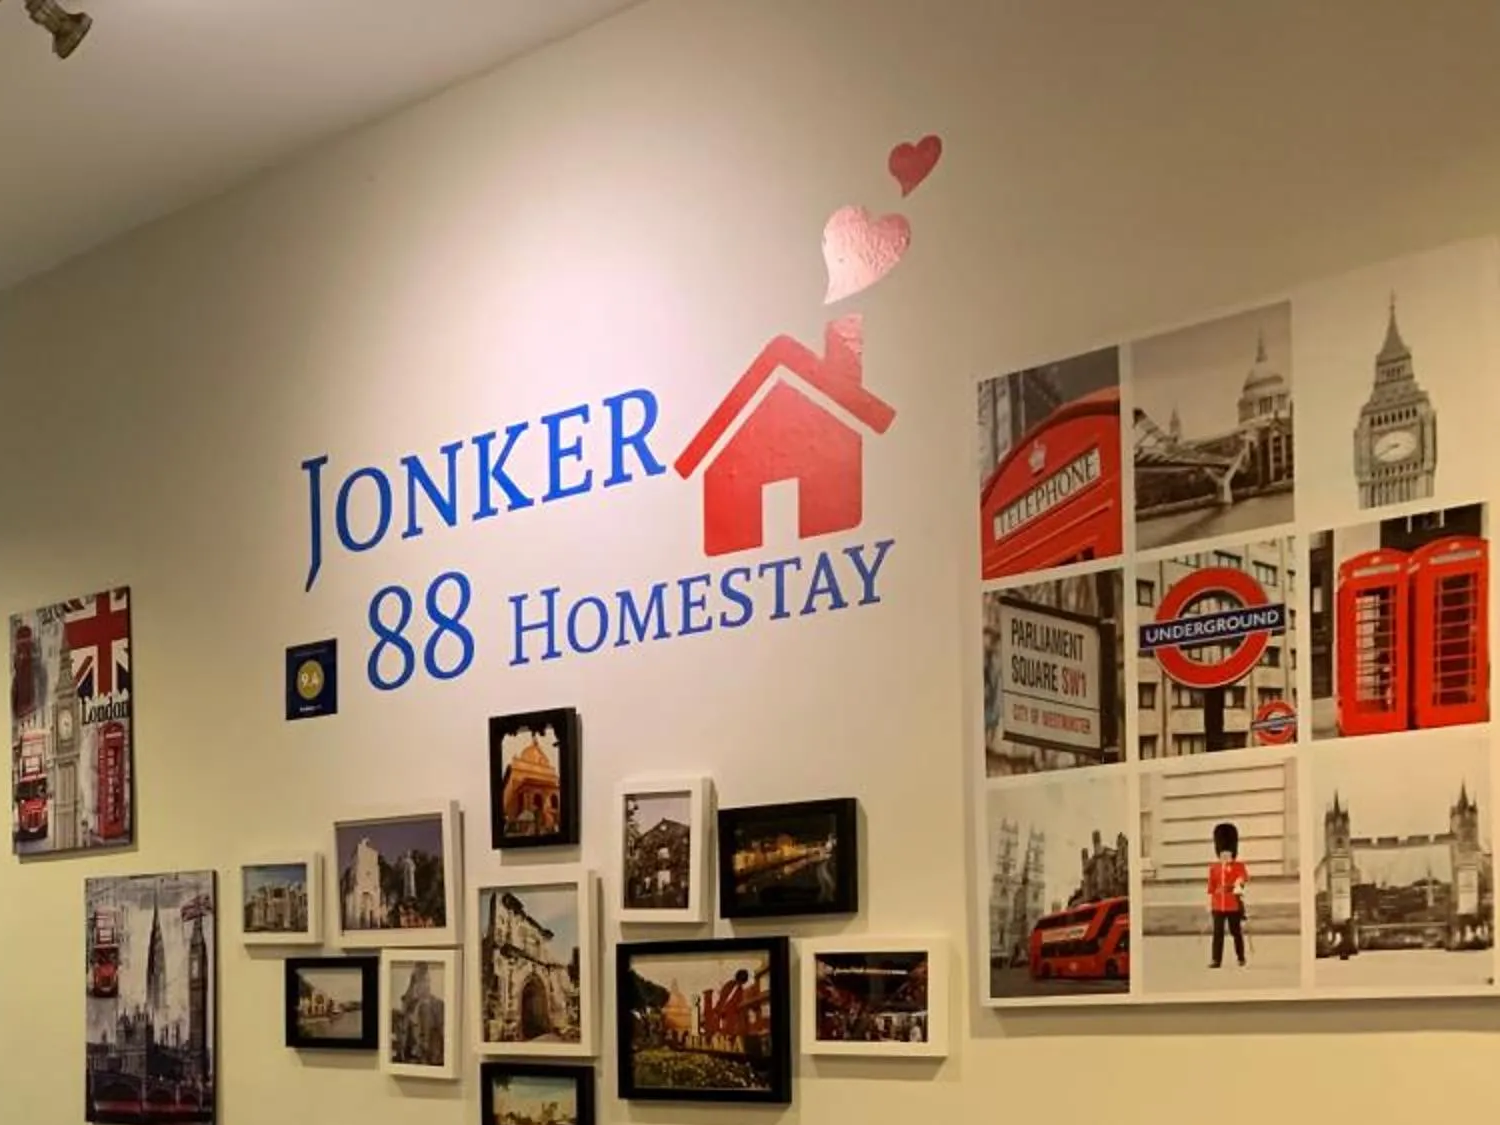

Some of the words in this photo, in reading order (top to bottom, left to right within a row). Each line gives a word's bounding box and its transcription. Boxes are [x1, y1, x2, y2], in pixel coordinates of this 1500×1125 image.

[301, 388, 667, 592] JONKER
[996, 450, 1097, 536] TELEPHONE
[366, 570, 476, 691] 88
[508, 538, 896, 667] HOMESTAY
[1144, 608, 1280, 644] UNDERGROUND
[1011, 617, 1085, 662] PARLIAMENT
[1011, 654, 1059, 692] SQUARE
[1061, 666, 1087, 698] SW1
[81, 696, 128, 726] London
